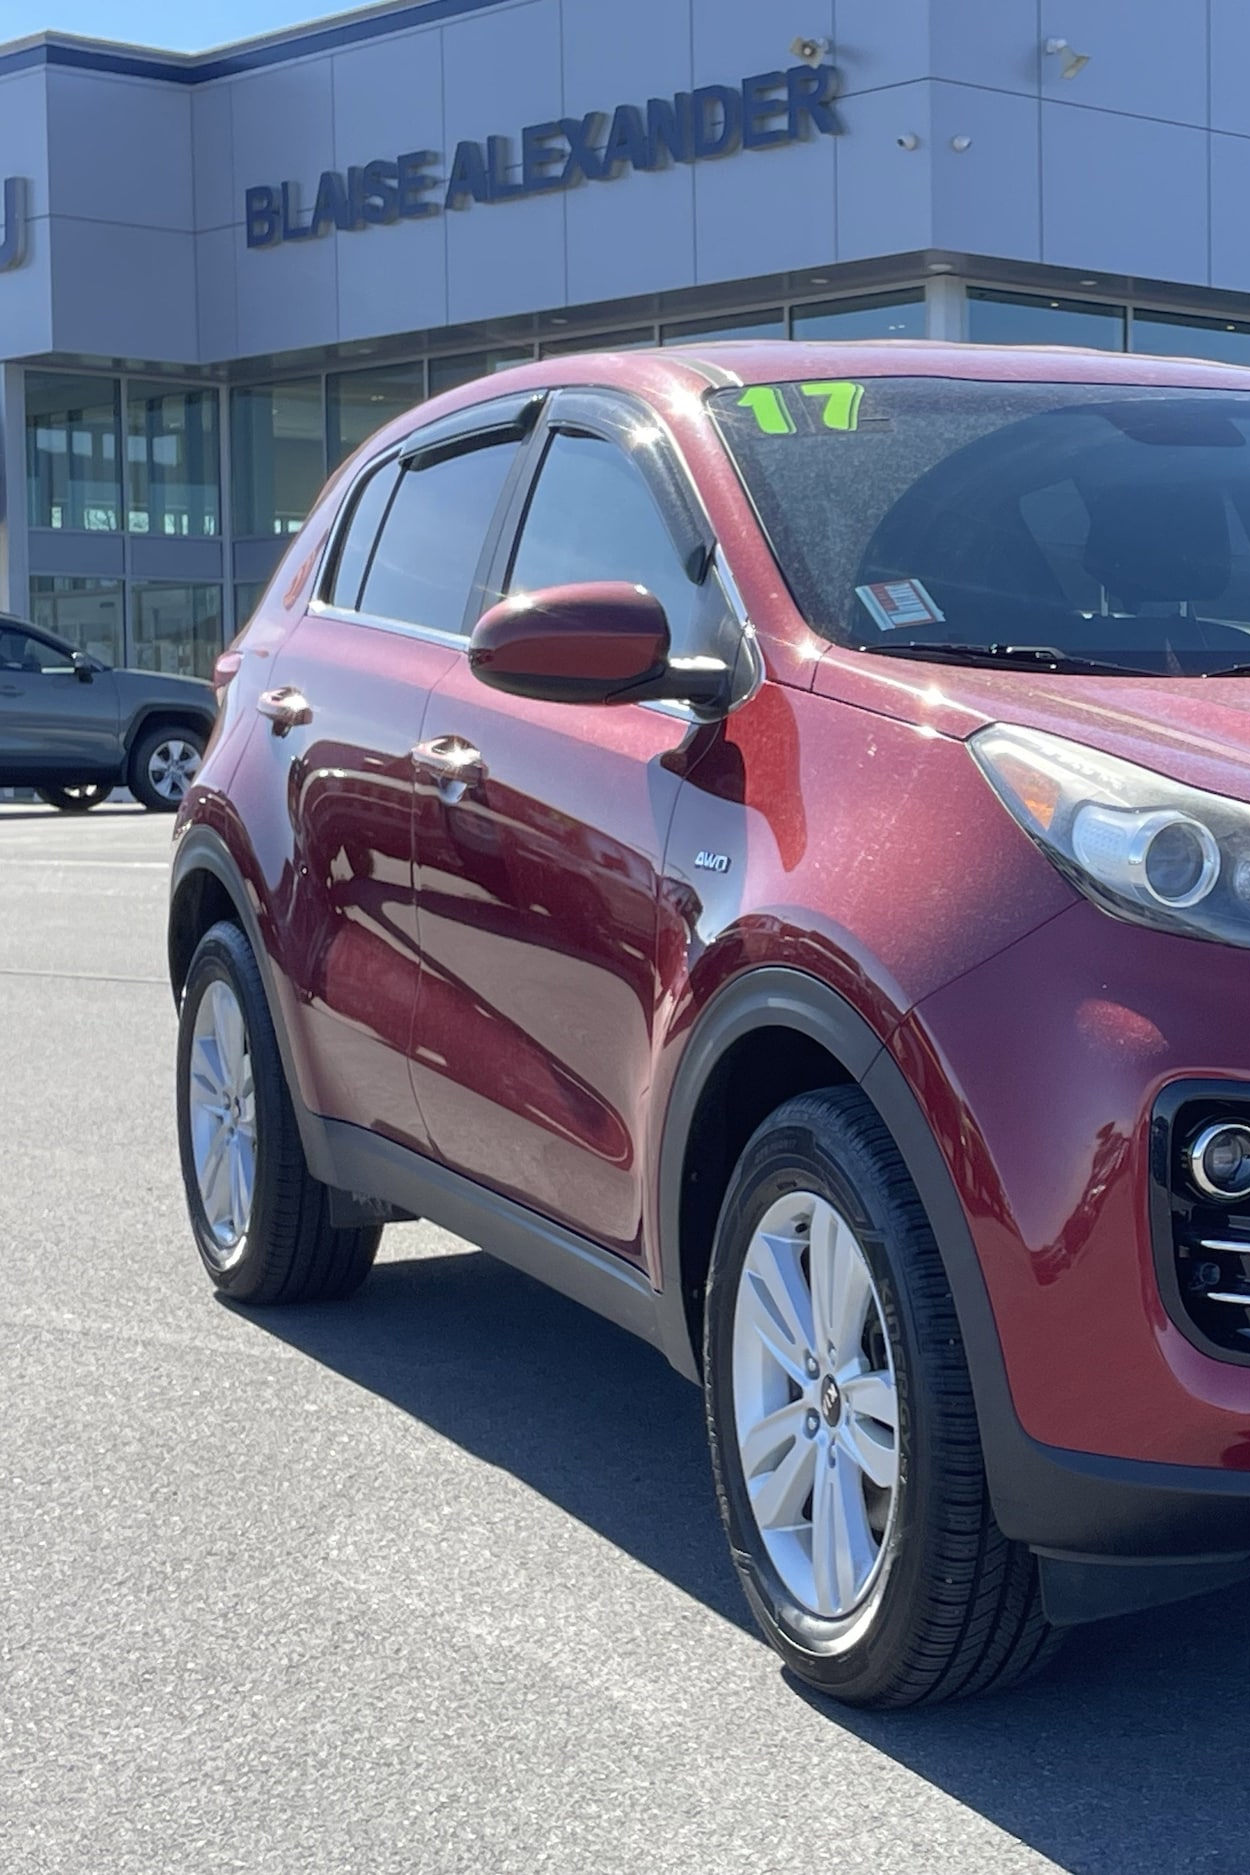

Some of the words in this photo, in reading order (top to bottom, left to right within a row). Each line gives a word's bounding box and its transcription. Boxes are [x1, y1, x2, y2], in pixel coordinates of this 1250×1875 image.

[246, 149, 440, 249] BLAISE
[444, 64, 845, 211] ALEXANDER
[737, 381, 864, 434] 17
[694, 851, 730, 872] AWD
